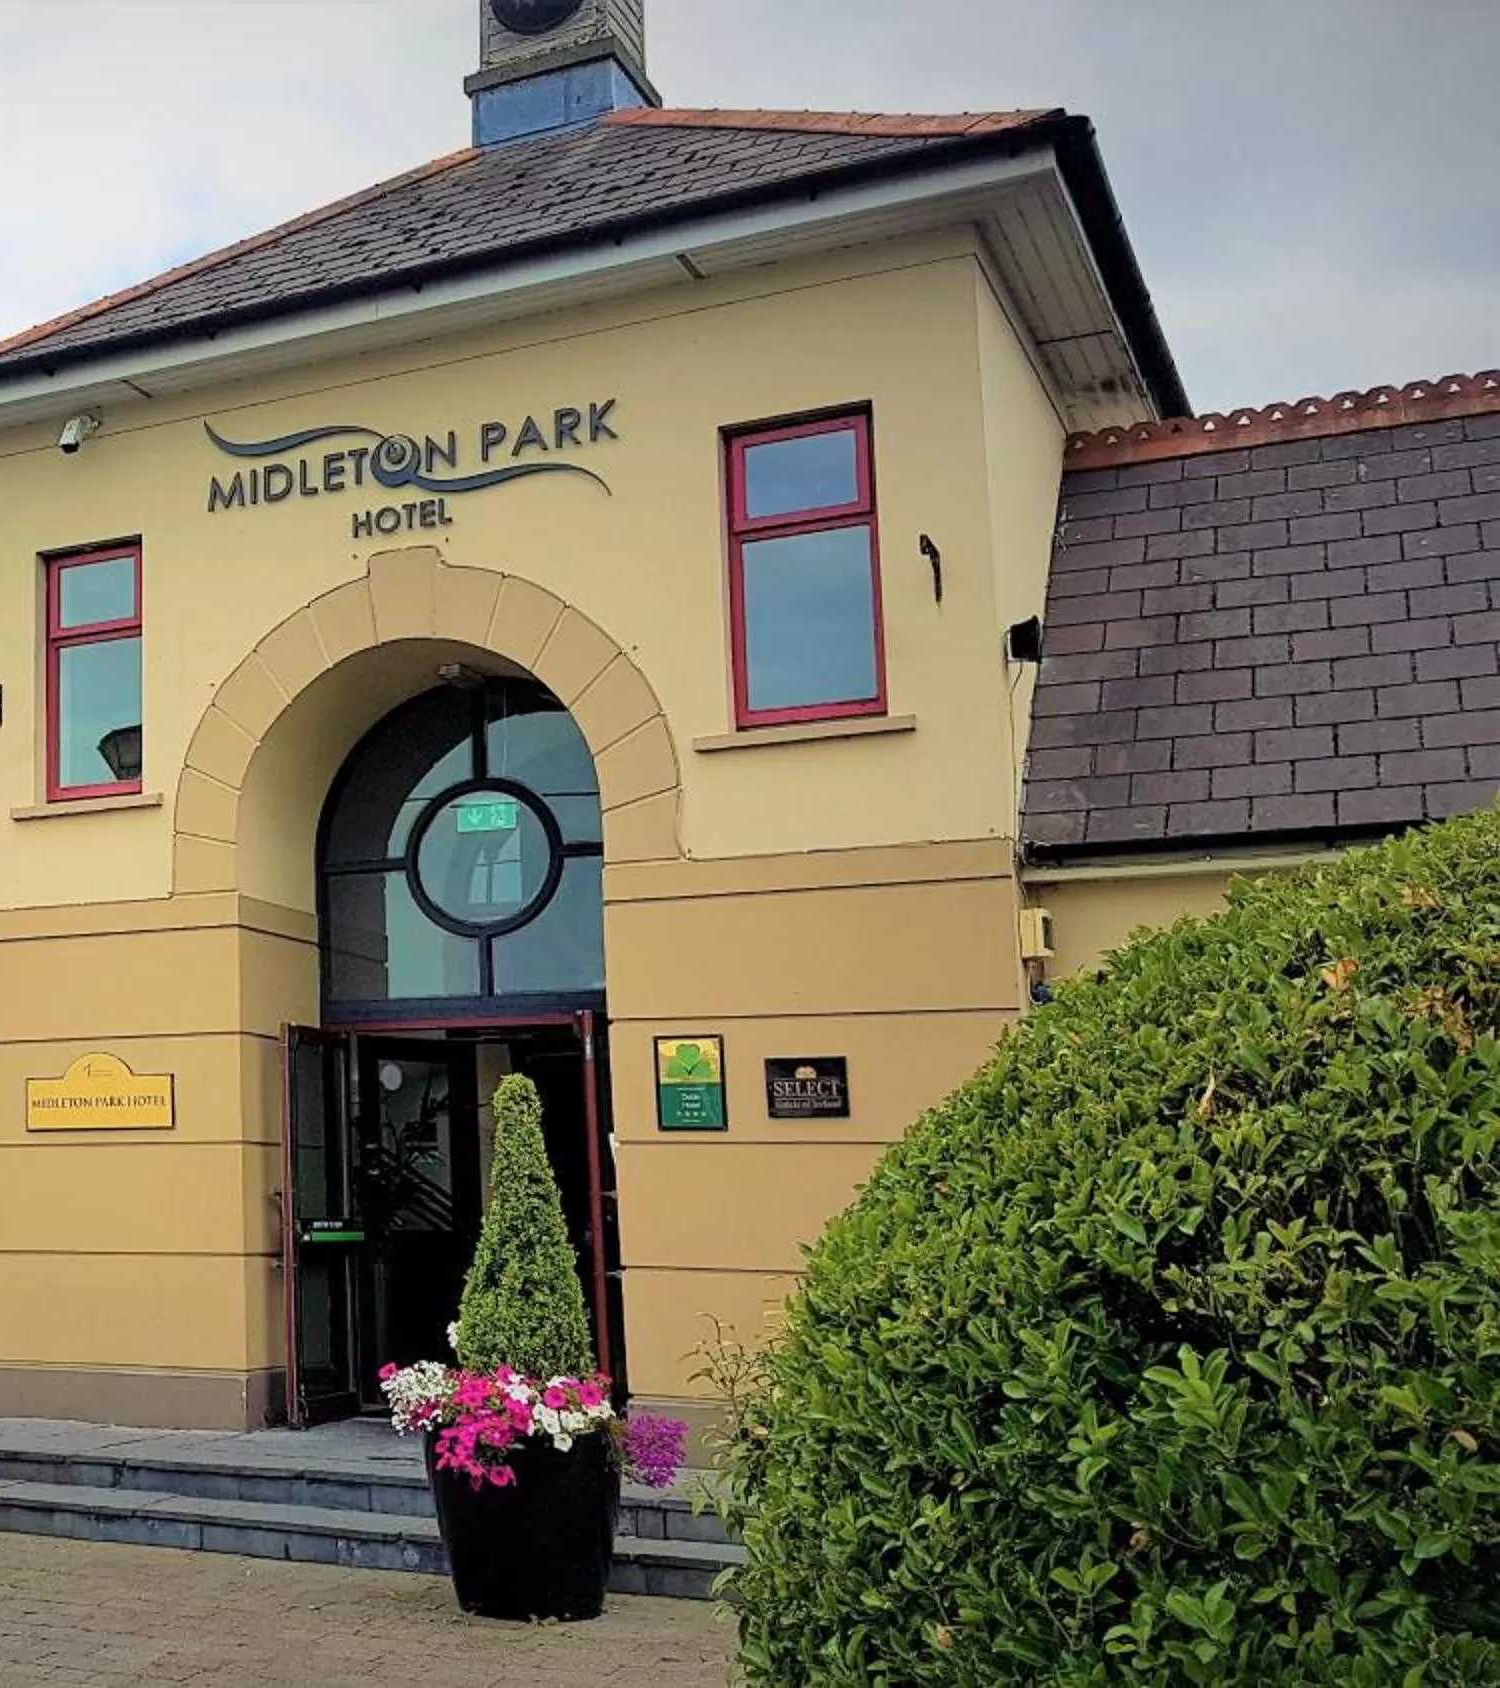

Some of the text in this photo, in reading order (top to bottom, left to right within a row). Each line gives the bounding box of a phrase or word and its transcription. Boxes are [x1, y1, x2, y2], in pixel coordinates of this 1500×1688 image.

[206, 398, 619, 513] MIDLETON PARK
[351, 497, 454, 539] HOTEL
[95, 1096, 125, 1107] PARK
[127, 1095, 167, 1107] HOTEL
[772, 1079, 840, 1098] SELECT
